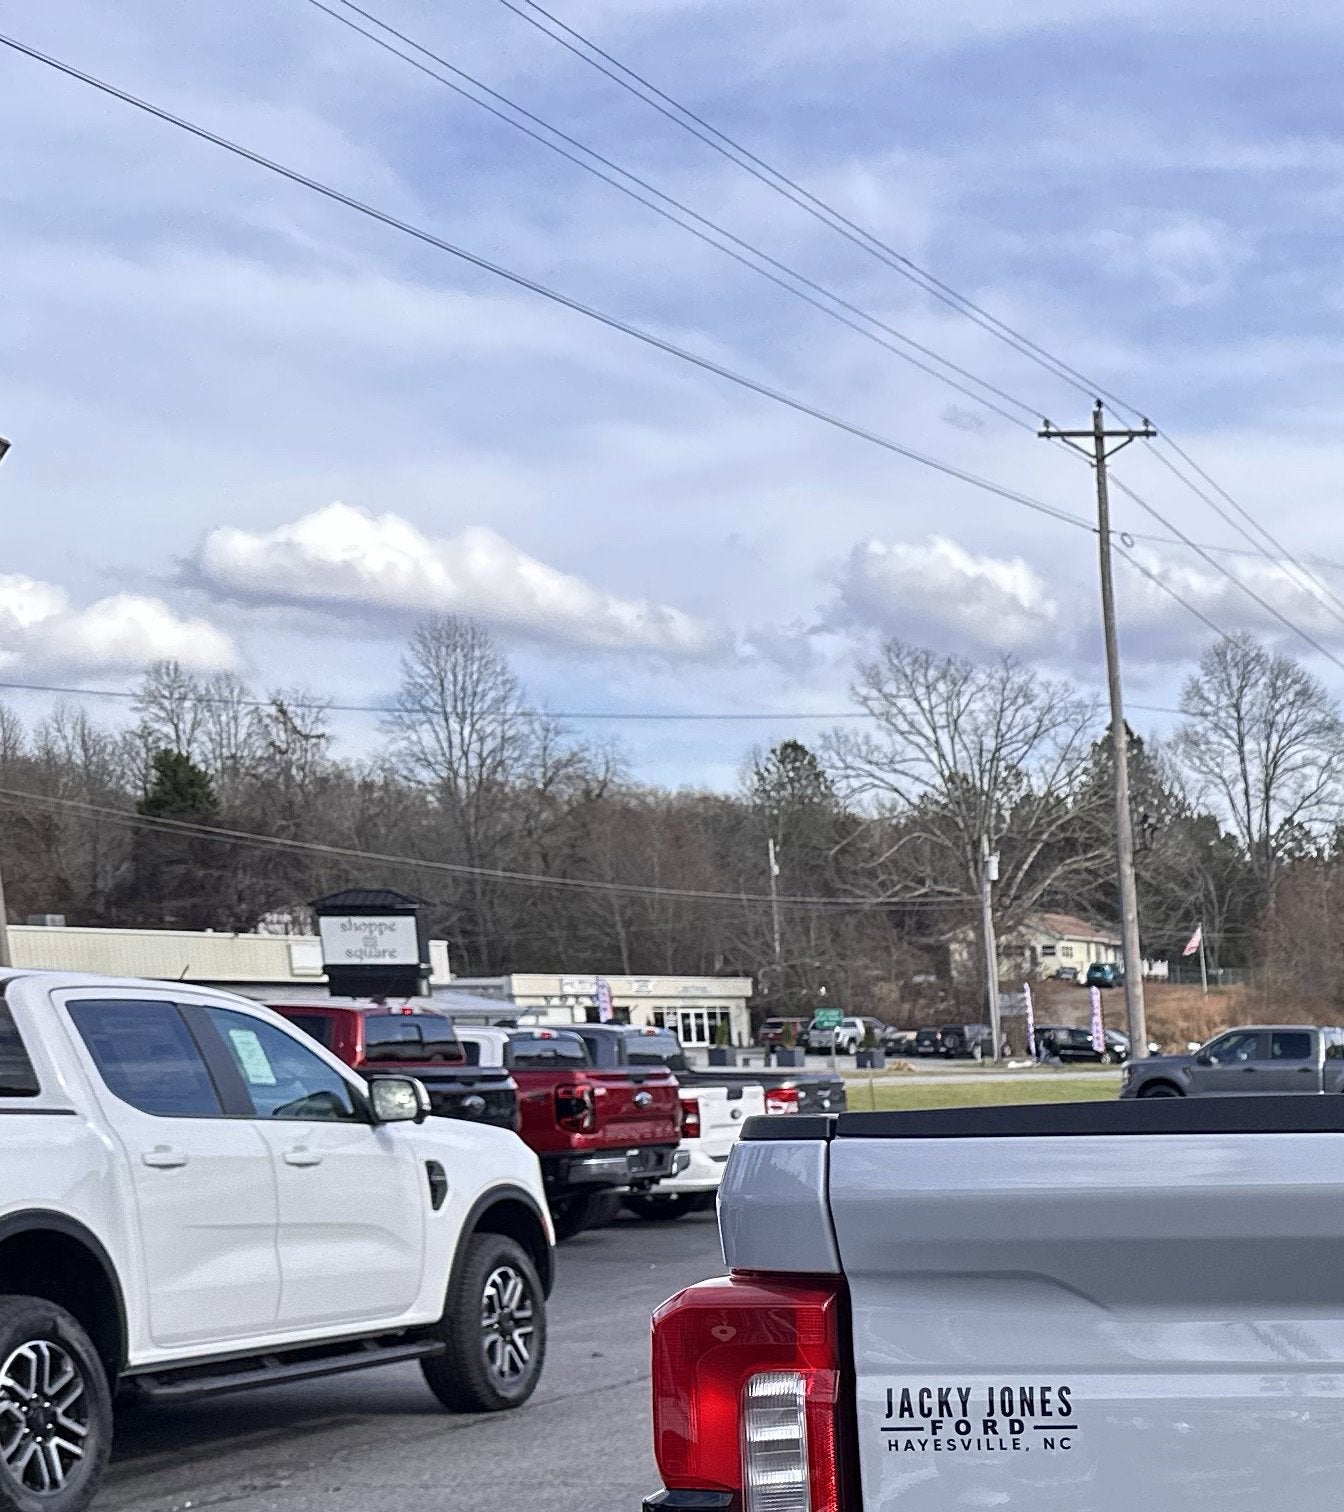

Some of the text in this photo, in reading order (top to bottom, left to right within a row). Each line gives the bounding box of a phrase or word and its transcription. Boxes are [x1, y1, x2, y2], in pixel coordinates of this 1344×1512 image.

[345, 948, 397, 960] square
[885, 1385, 1073, 1418] JACKY JONES
[930, 1418, 1026, 1436] FORD
[887, 1436, 1073, 1452] HAYESVILLE, NC
